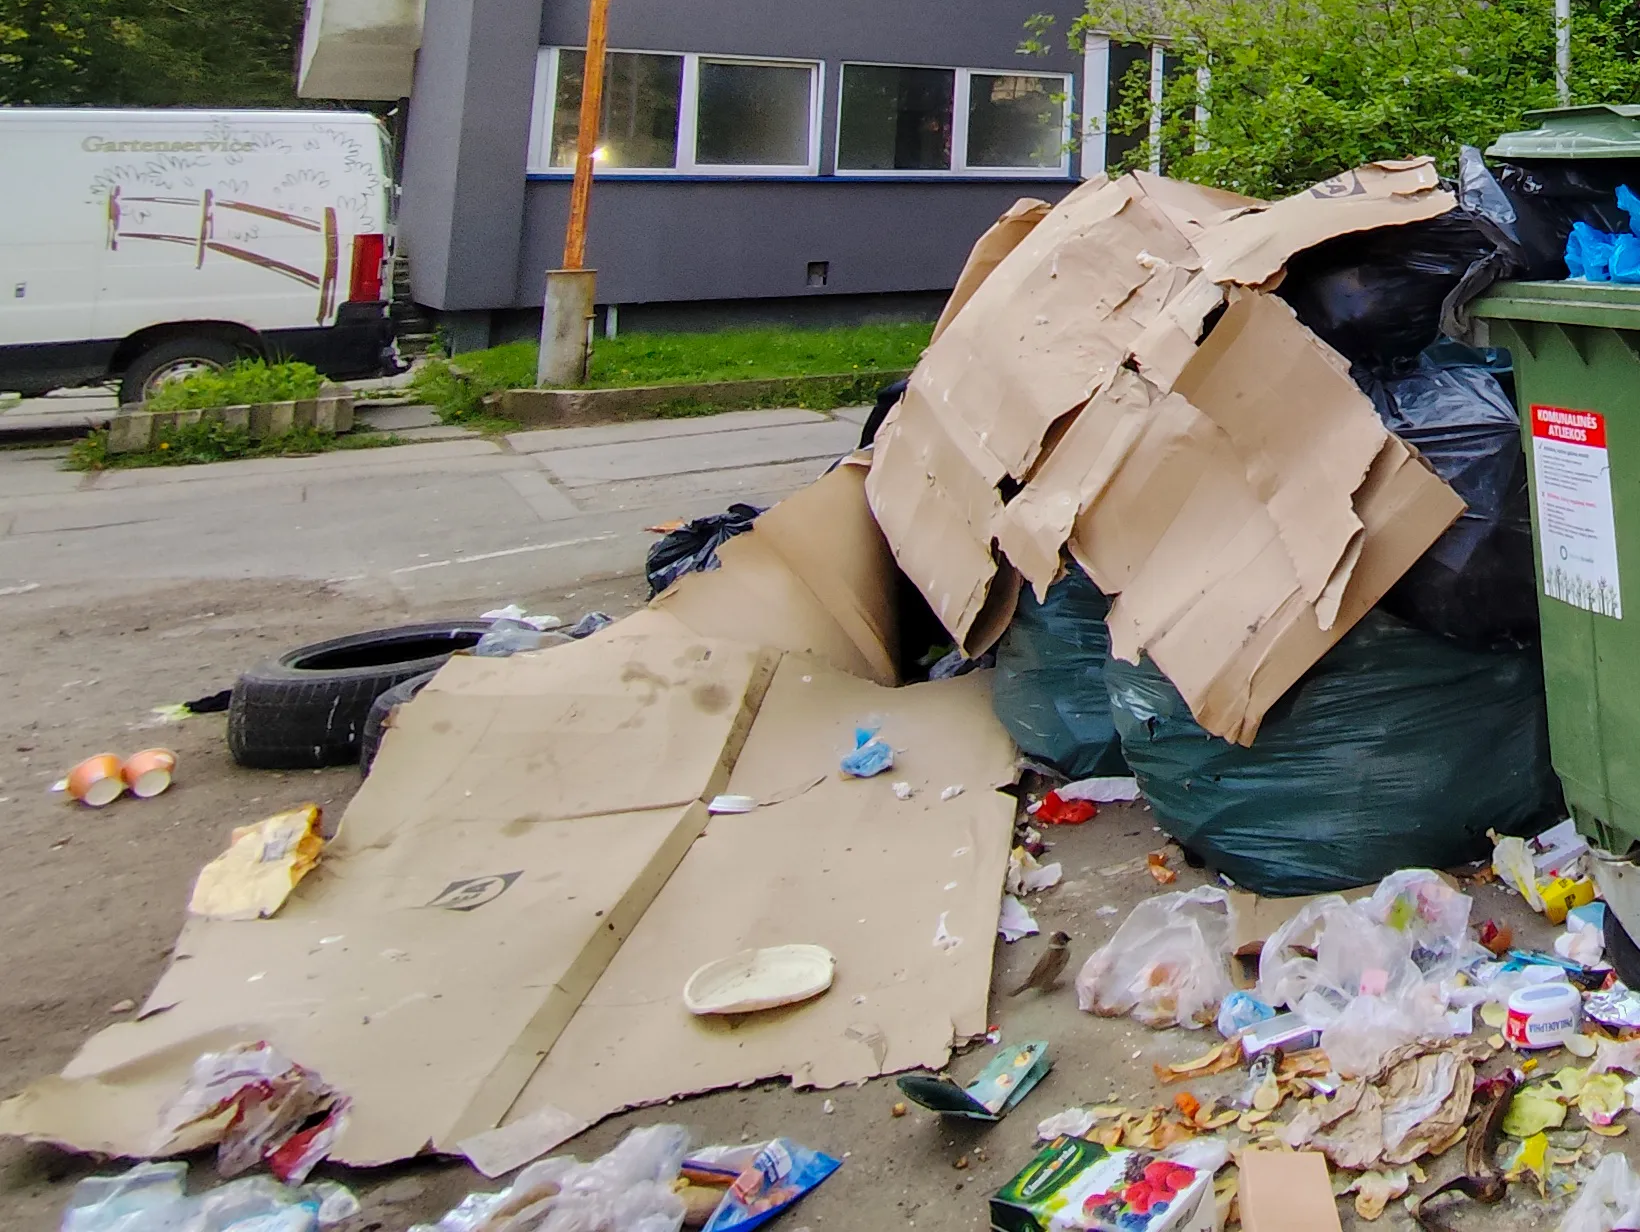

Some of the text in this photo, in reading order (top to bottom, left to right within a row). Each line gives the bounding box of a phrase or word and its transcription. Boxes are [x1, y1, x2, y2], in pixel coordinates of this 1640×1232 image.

[81, 135, 256, 153] Gartenservice
[1536, 408, 1598, 430] KOMUNALINĖS
[1547, 423, 1588, 442] ATLIEKOS
